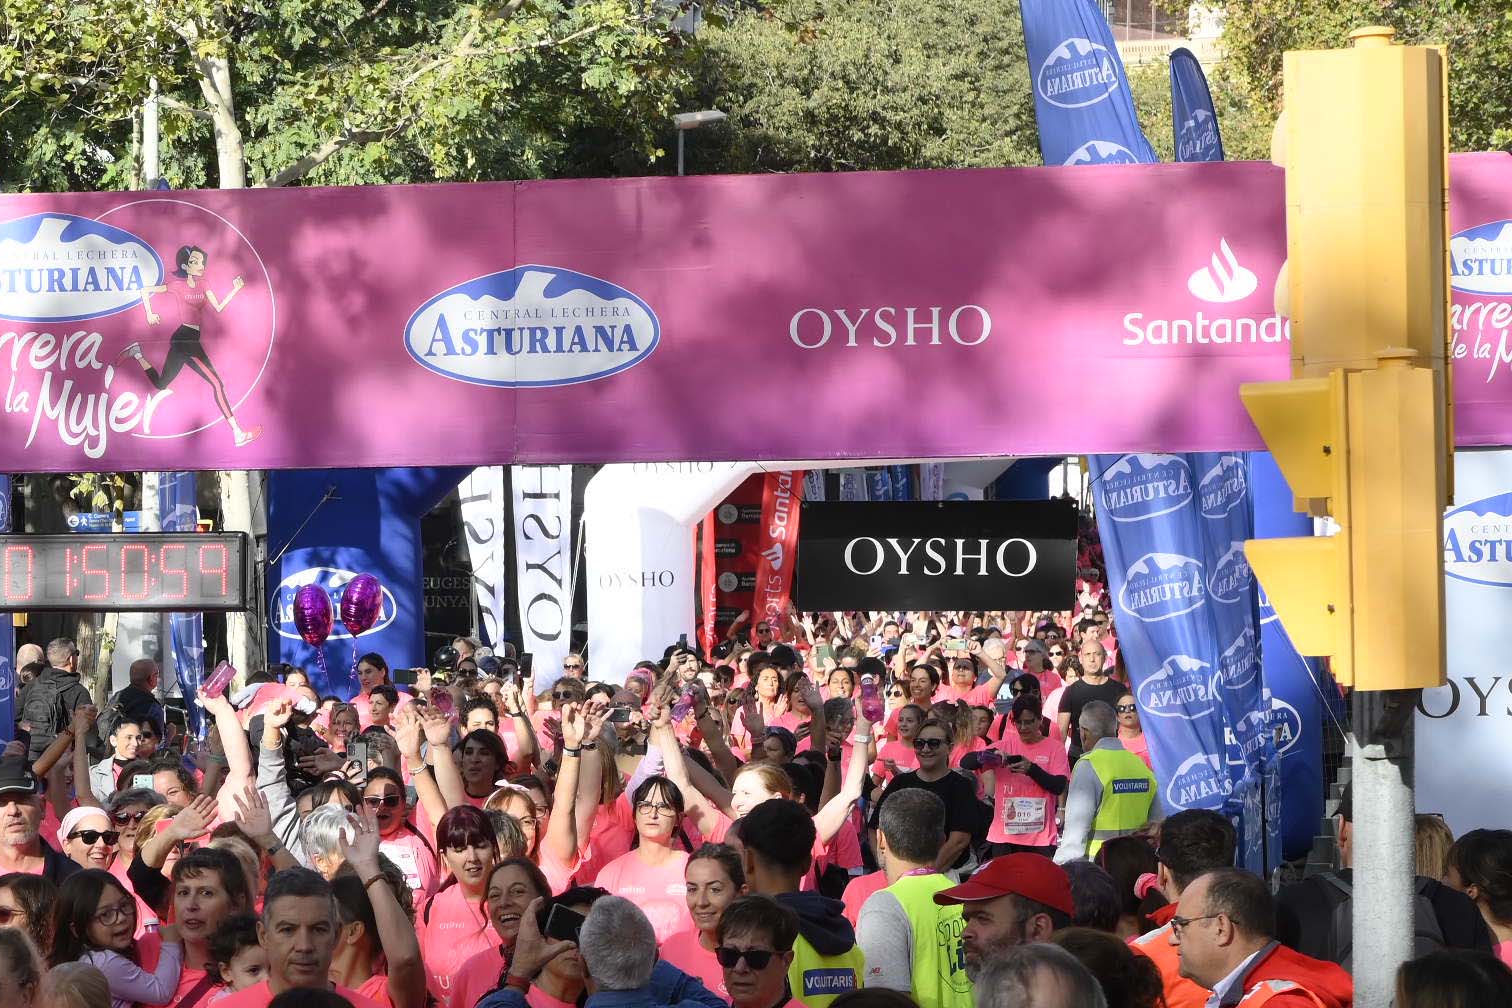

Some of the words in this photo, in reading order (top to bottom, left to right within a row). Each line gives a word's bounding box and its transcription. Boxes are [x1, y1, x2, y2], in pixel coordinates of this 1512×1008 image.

[66, 249, 140, 262] LECHERA
[463, 306, 542, 320] CENTRAL
[548, 304, 632, 319] LECHERA
[788, 304, 993, 349] OYSHO
[424, 320, 640, 358] ASTURIANA
[4, 375, 30, 414] la
[25, 365, 175, 459] Mujer
[4, 544, 228, 600] 01:50:59
[843, 536, 1038, 577] OYSHO
